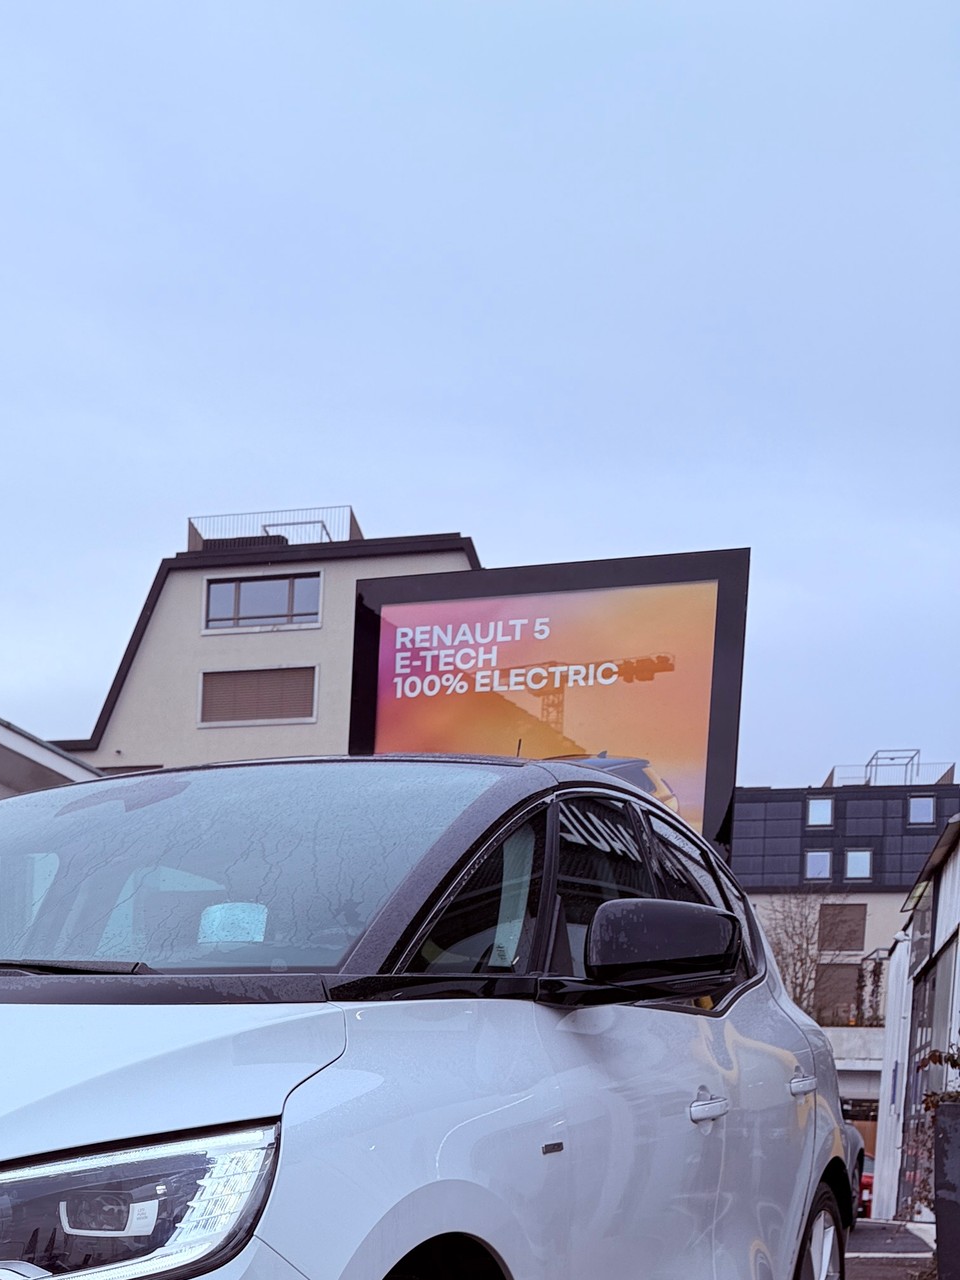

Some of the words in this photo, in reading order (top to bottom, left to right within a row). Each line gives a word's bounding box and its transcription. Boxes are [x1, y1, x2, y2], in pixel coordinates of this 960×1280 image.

[395, 618, 528, 650] RENAULT
[533, 617, 551, 640] 5
[394, 646, 498, 674] E-TECH
[392, 671, 469, 699] 100%
[475, 662, 620, 693] ELECTRIC
